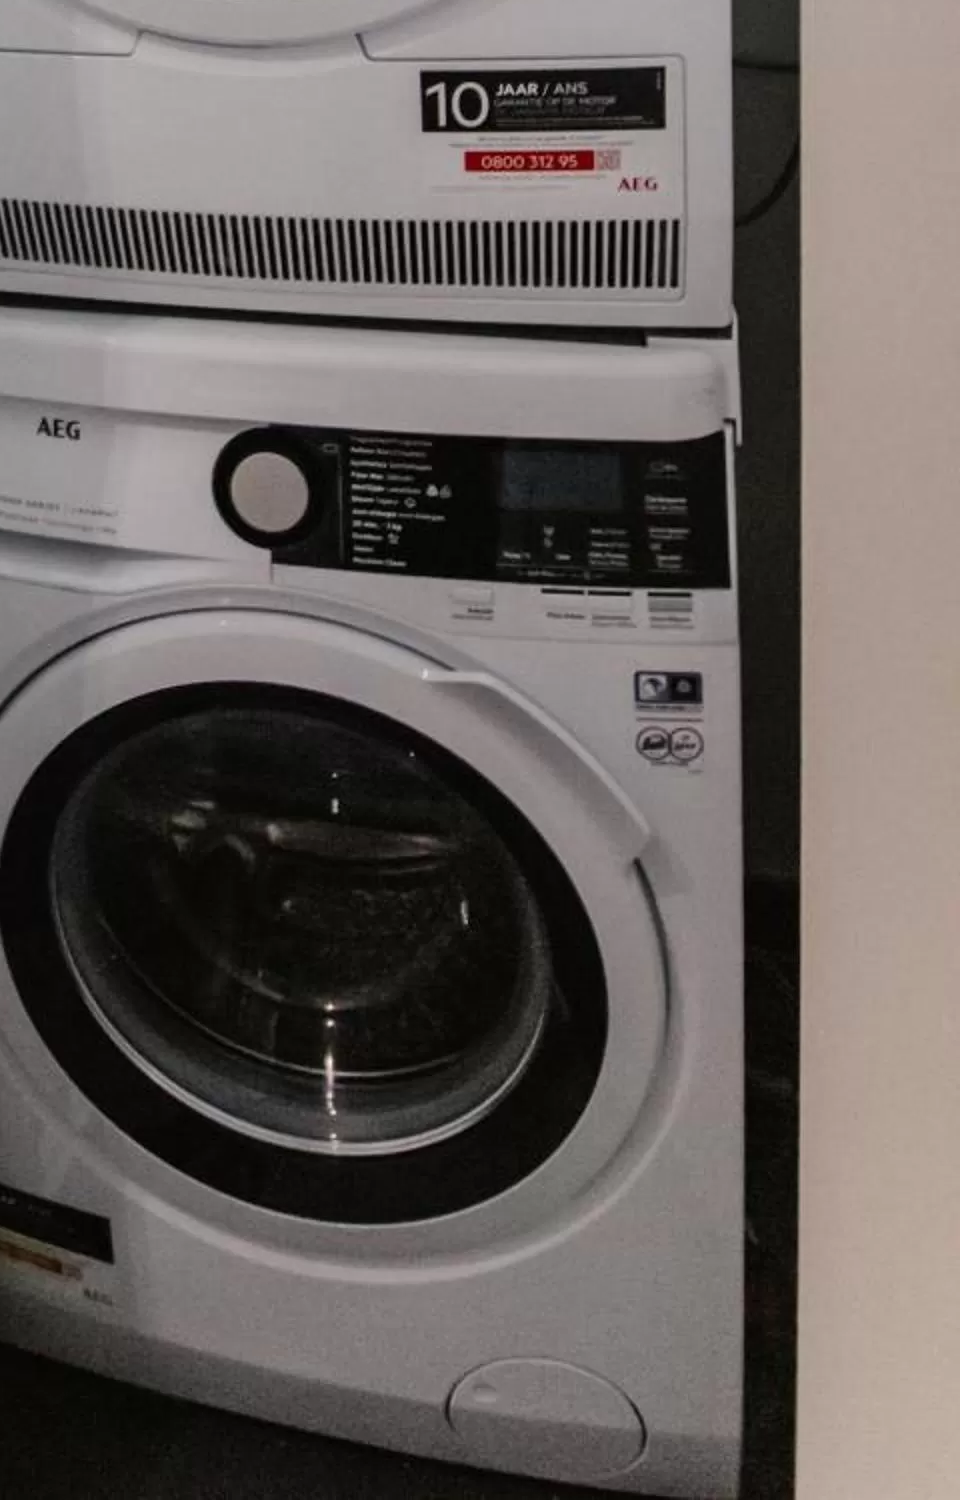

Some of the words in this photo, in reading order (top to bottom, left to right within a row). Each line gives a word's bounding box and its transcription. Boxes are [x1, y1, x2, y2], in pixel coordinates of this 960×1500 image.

[425, 81, 490, 128] 10
[496, 83, 538, 97] JAAR
[552, 81, 588, 96] ANS
[481, 155, 525, 170] 0800
[529, 155, 553, 169] 312
[558, 154, 578, 169] 95
[617, 177, 658, 193] AEG
[37, 417, 81, 441] AEG
